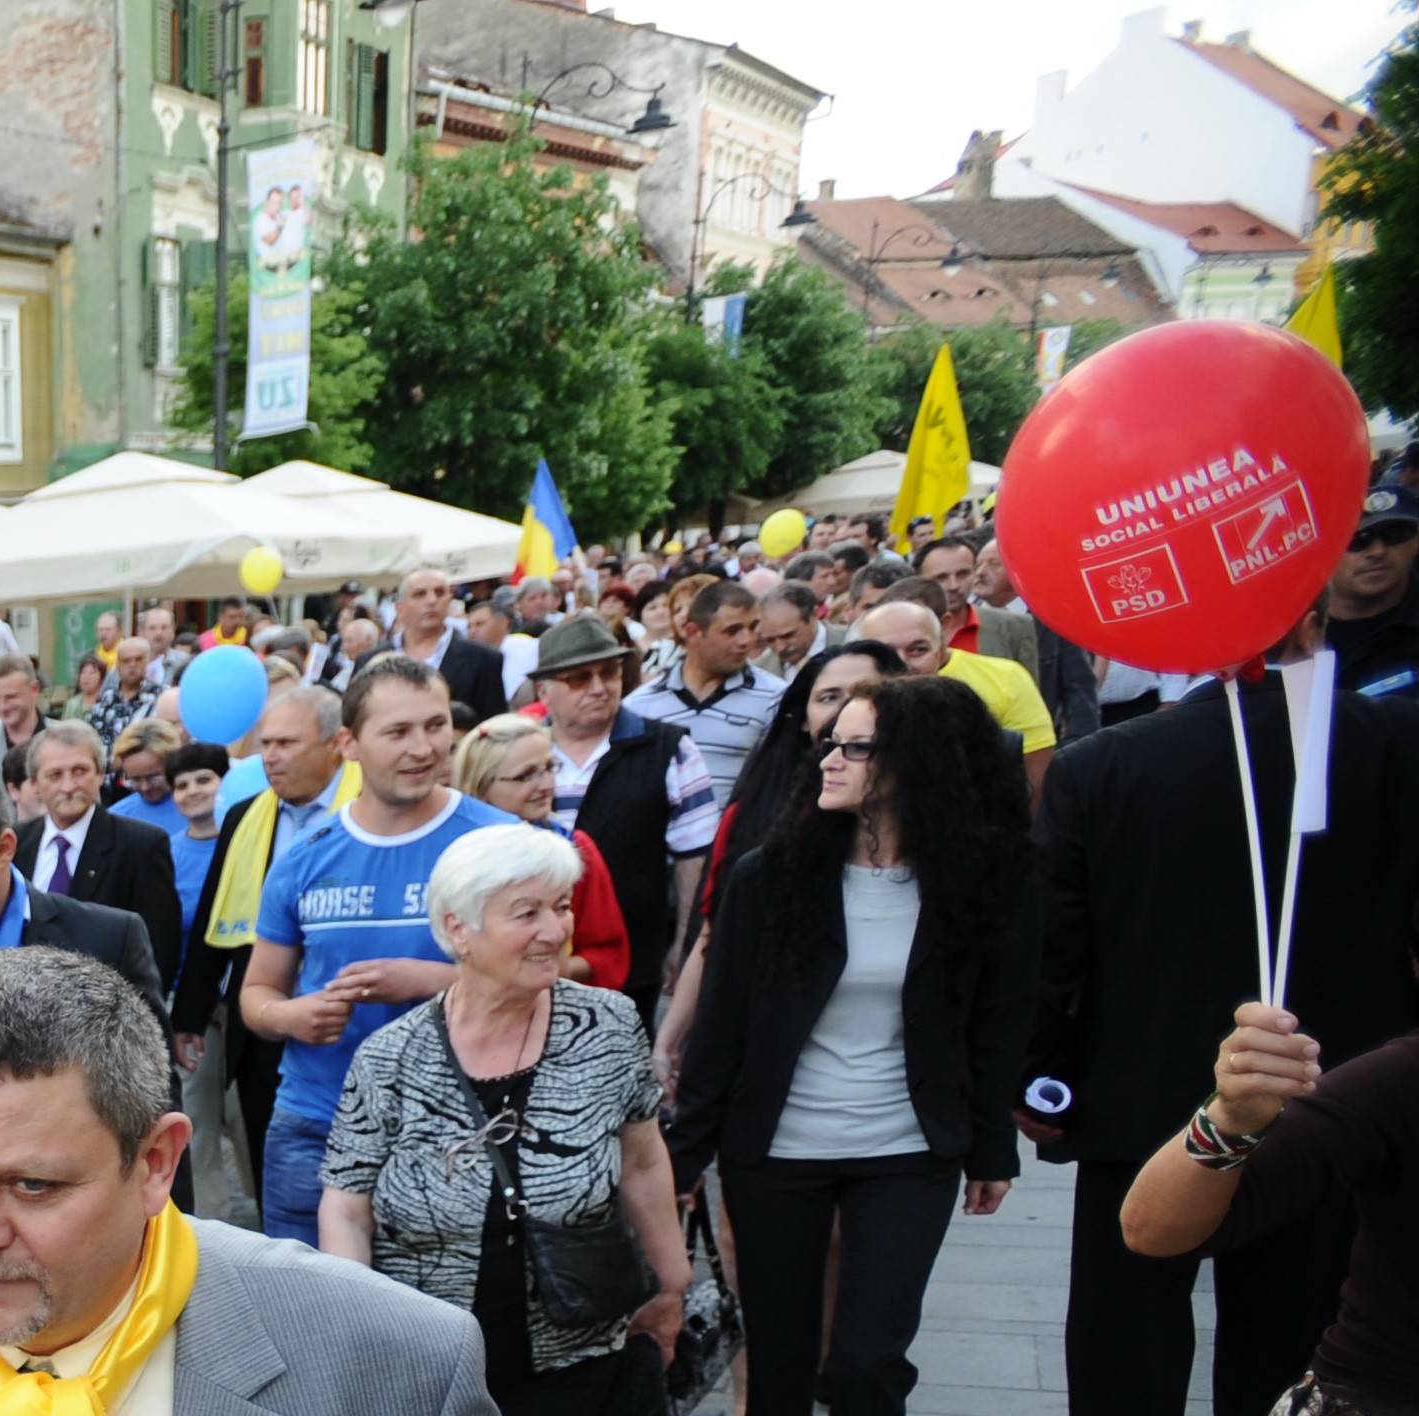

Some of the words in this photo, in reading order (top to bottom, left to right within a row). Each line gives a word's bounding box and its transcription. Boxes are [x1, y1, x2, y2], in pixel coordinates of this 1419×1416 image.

[1095, 447, 1255, 526] UNIUNEA
[1081, 517, 1164, 552] SOCIAL
[1112, 588, 1166, 616] PSD
